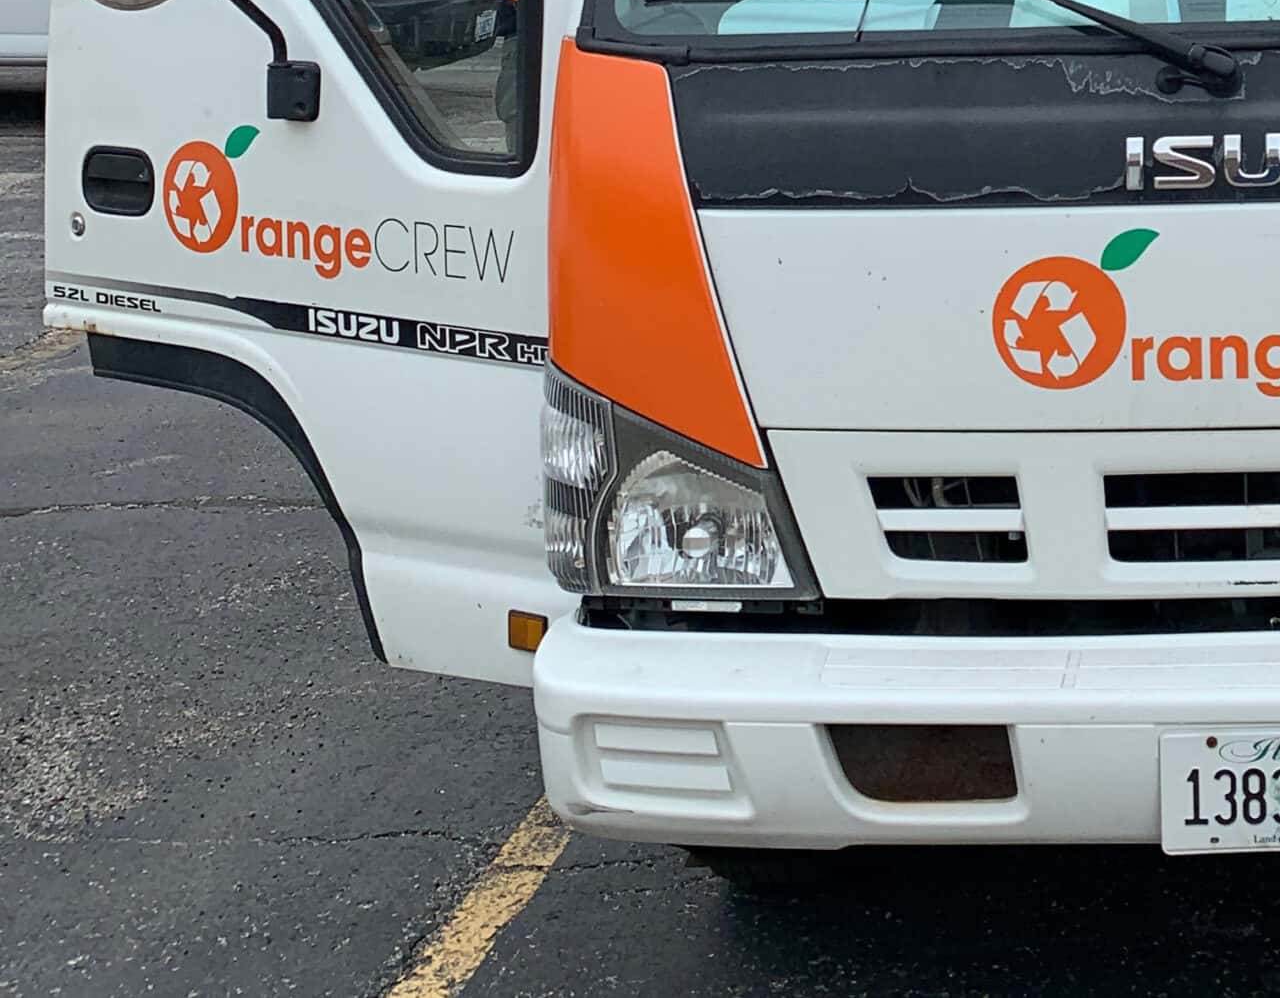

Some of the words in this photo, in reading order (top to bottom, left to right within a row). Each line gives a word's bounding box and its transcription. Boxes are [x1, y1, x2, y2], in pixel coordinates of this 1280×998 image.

[96, 292, 161, 312] DIESEL
[308, 308, 400, 344] ISUZU
[416, 322, 512, 361] NPR
[1253, 833, 1276, 844] Land
